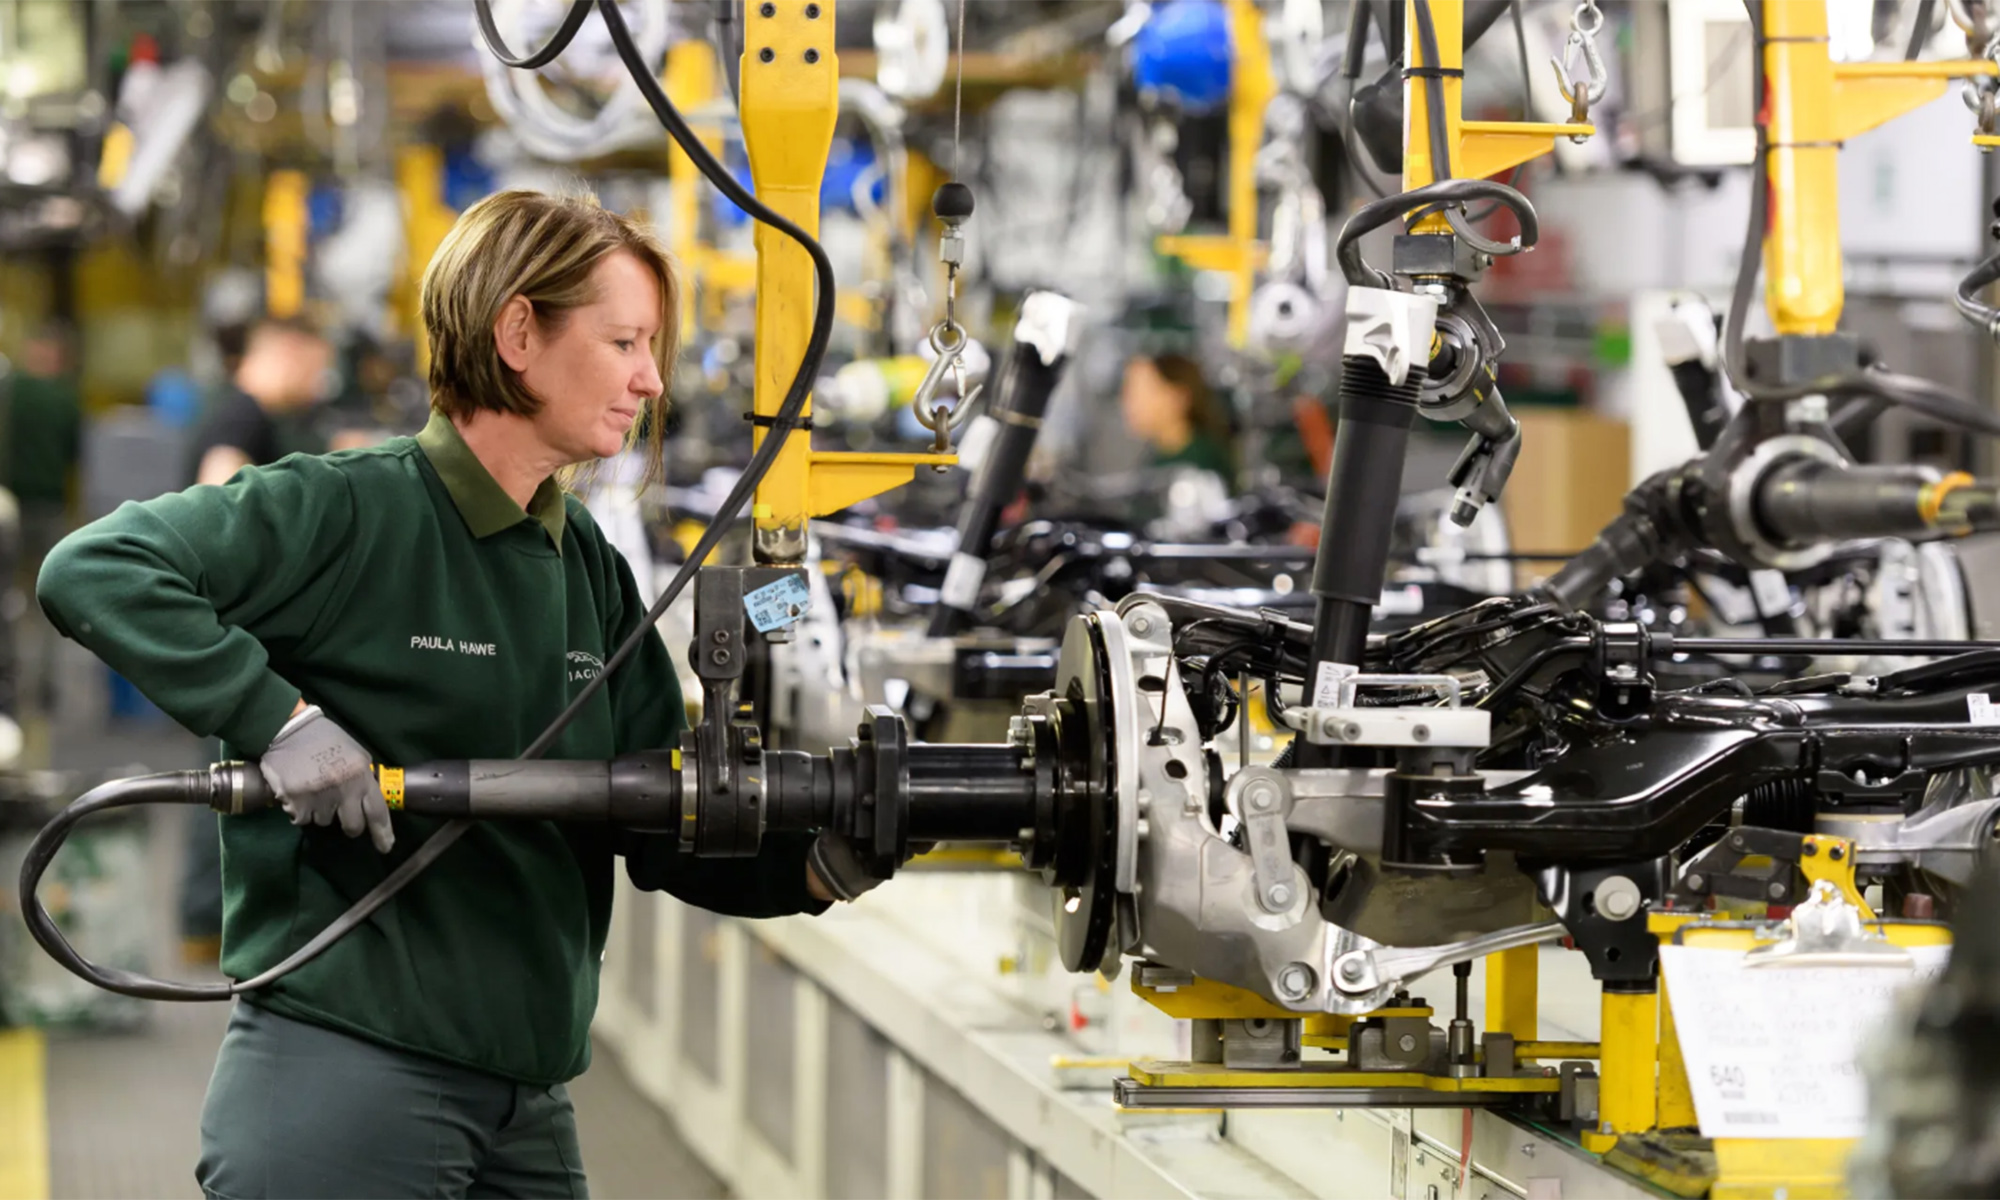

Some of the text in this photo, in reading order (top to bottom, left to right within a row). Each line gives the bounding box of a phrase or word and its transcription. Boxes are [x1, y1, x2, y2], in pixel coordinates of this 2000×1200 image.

[410, 636, 497, 656] PAULA HAWE
[1709, 1065, 1746, 1088] 640
